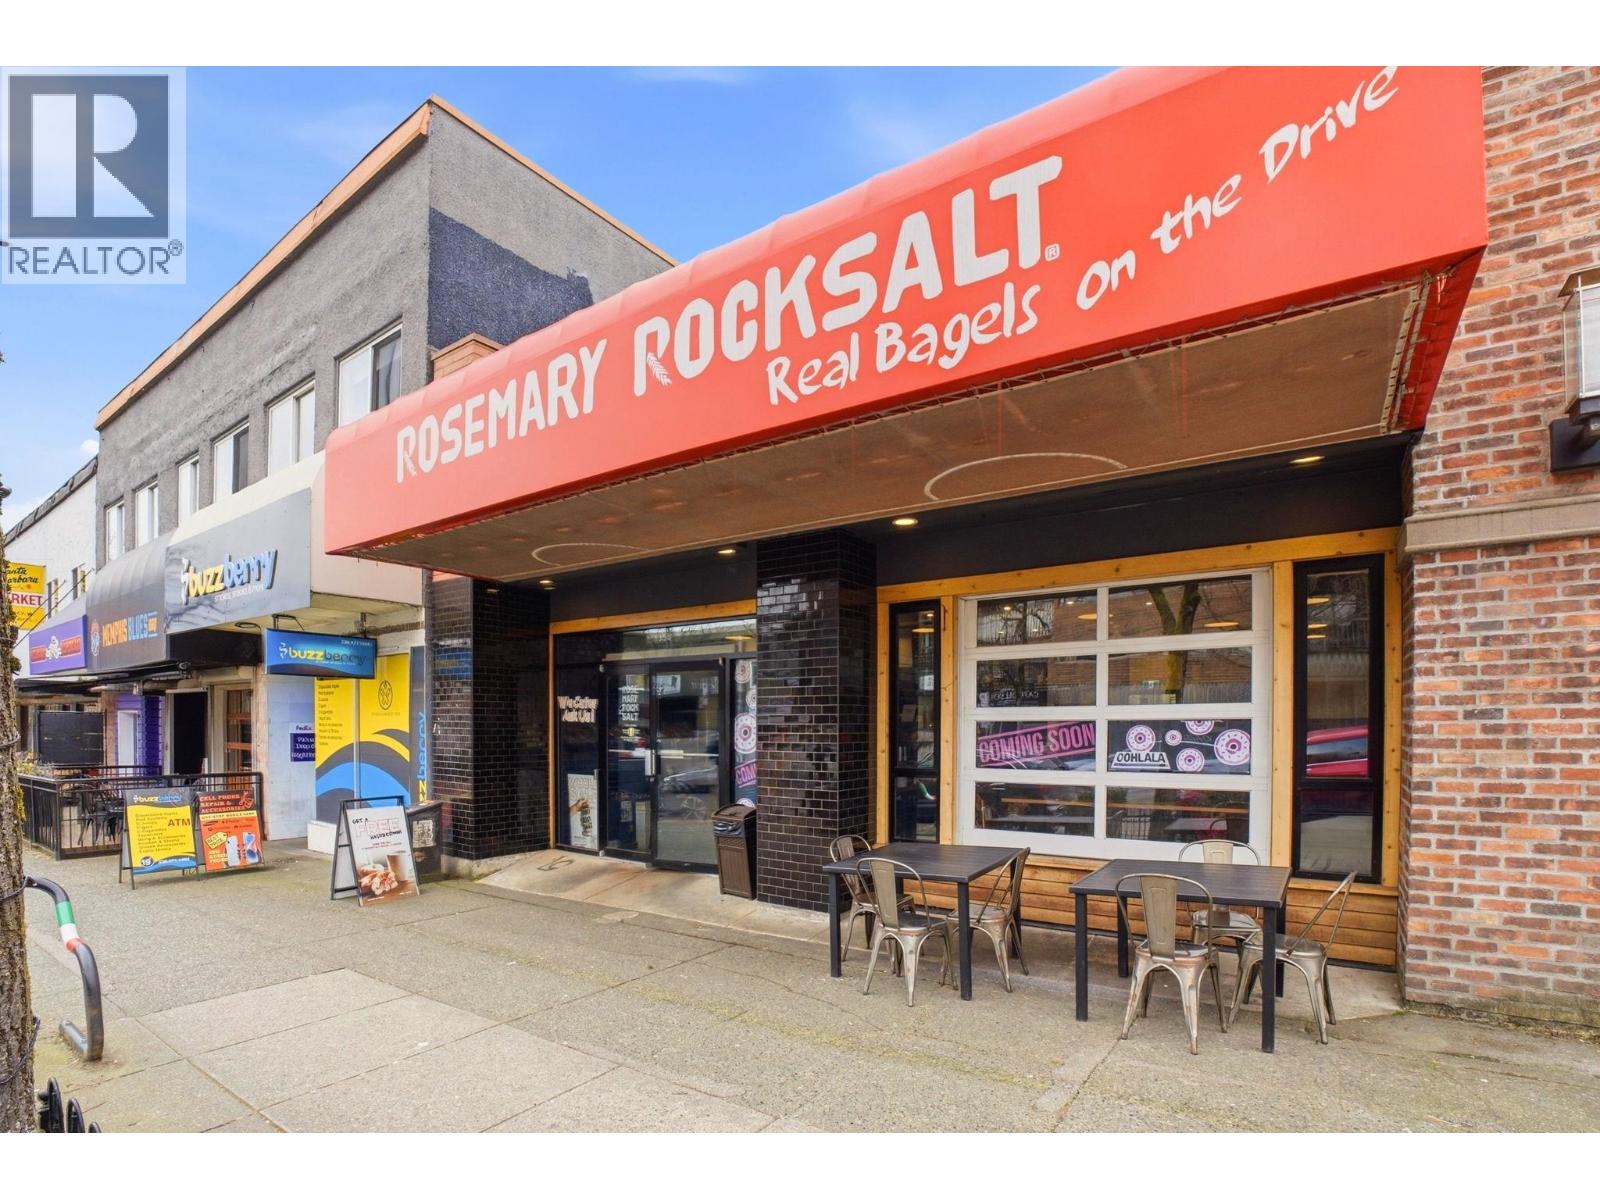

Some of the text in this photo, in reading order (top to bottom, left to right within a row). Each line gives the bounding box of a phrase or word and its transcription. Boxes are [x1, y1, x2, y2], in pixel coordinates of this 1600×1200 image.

[767, 334, 859, 405] Real
[875, 282, 1041, 370] Bagels
[1149, 174, 1242, 255] the
[1259, 66, 1399, 183] Drive
[396, 337, 607, 484] ROSEMARY
[188, 549, 278, 598] buzzberry
[11, 593, 43, 606] RKET
[288, 646, 366, 666] buzzberry
[622, 712, 639, 721] SALT
[978, 723, 1096, 763] COMING SOON
[167, 818, 191, 827] ATM
